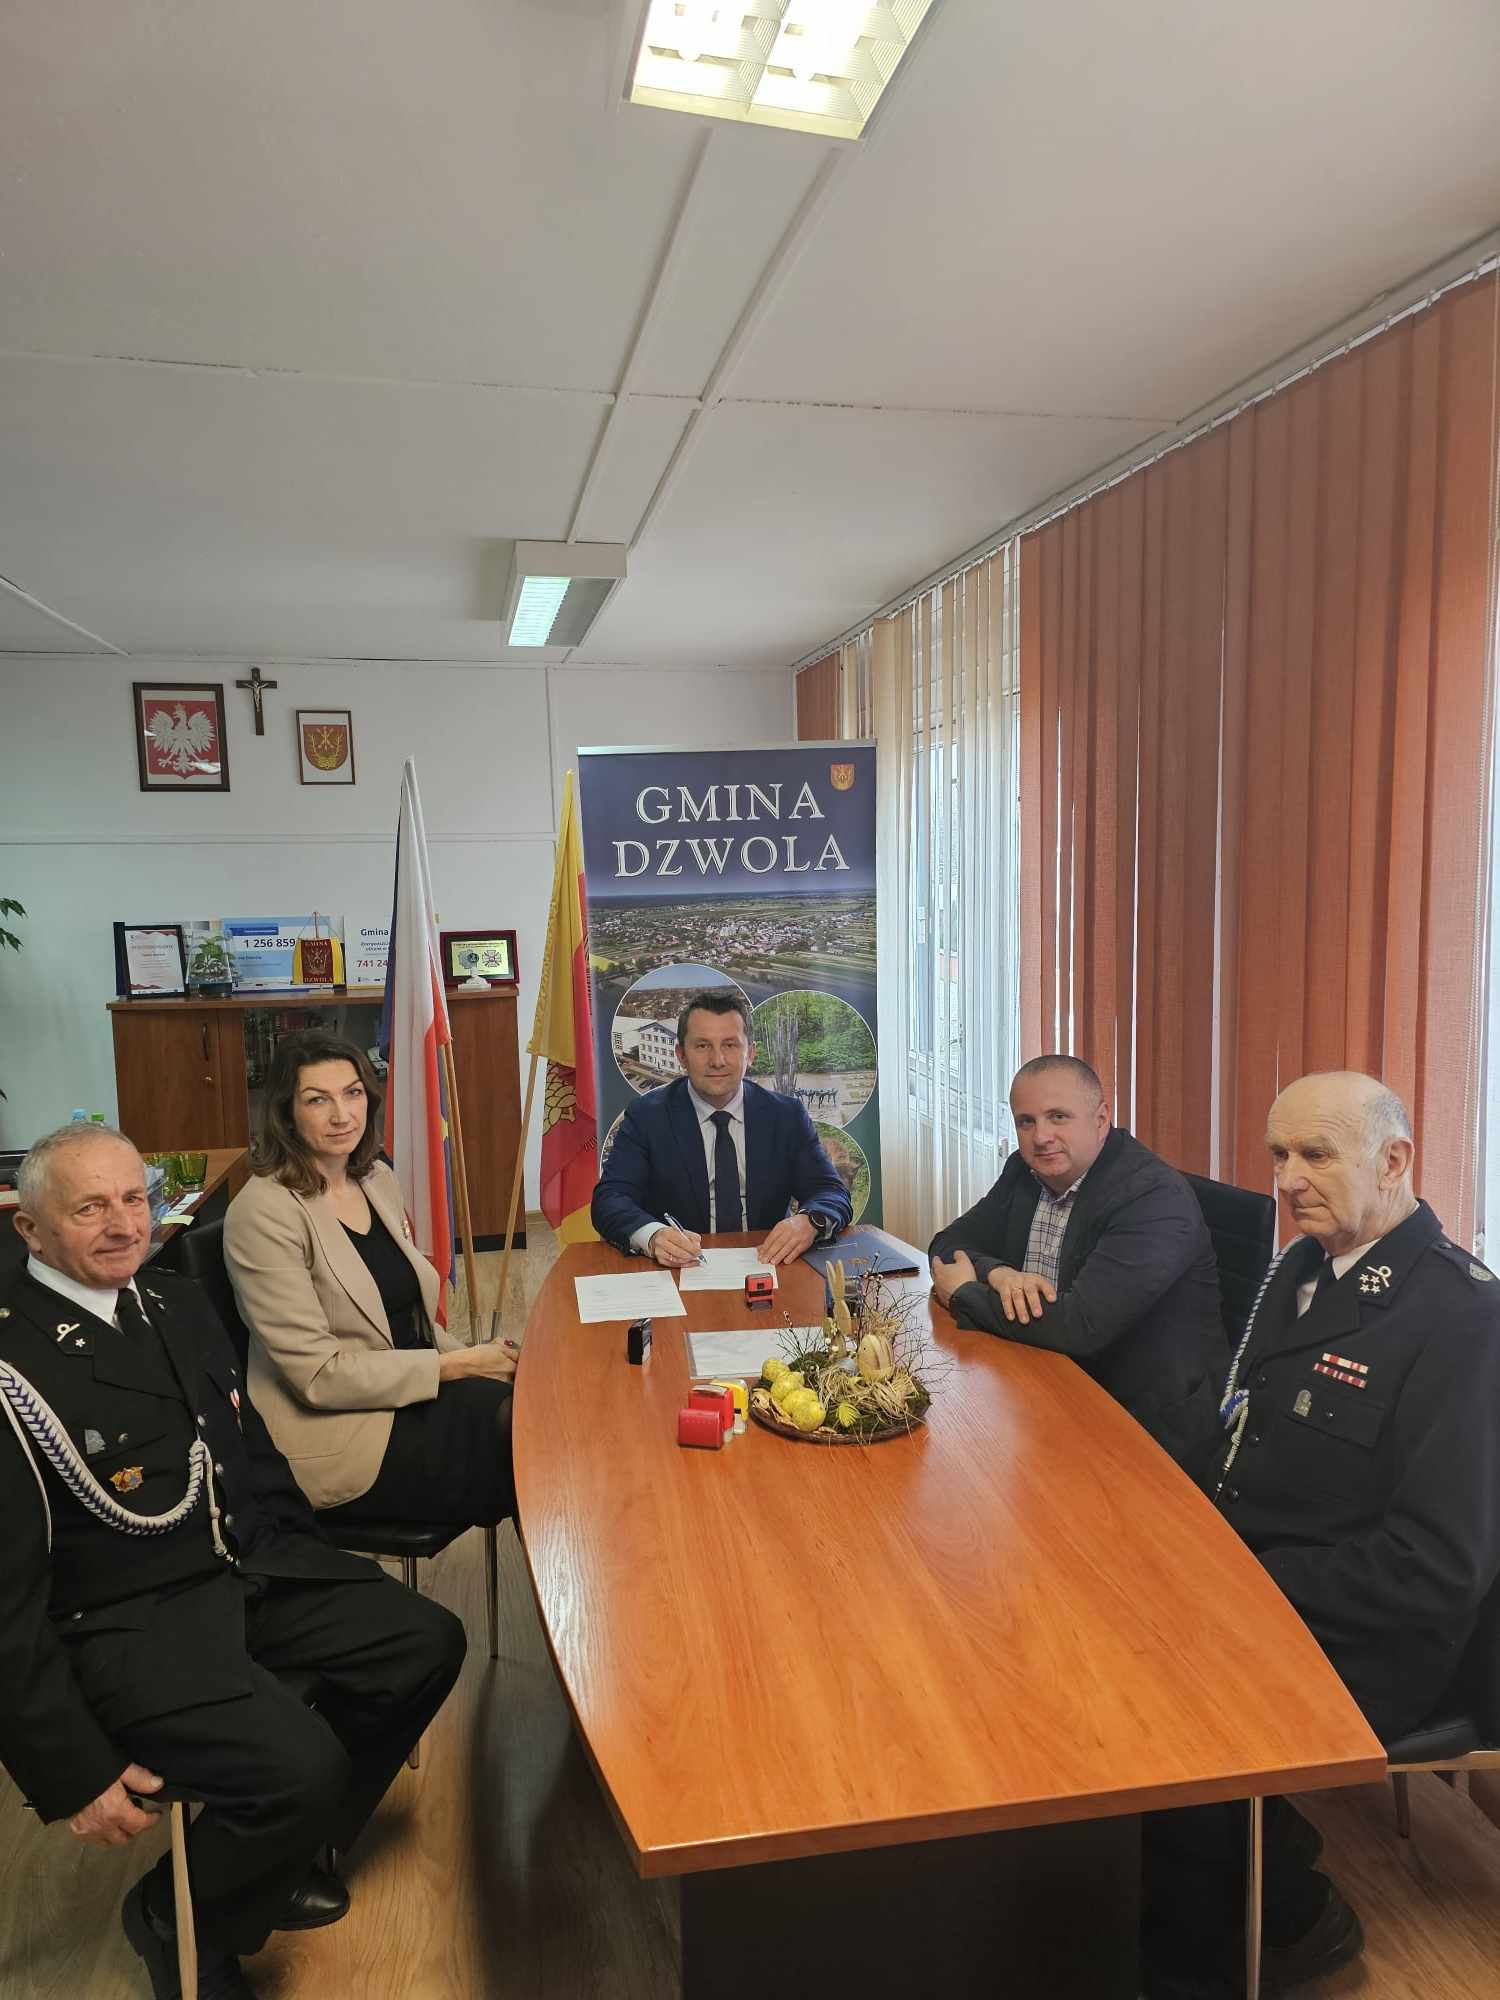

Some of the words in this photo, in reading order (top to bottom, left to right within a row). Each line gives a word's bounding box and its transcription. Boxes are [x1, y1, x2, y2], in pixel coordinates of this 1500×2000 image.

[636, 781, 825, 824] GMINA
[612, 834, 851, 878] DZWOLA
[360, 928, 389, 936] Gmina
[243, 939, 249, 948] 1
[254, 939, 273, 947] 256
[276, 938, 296, 947] 859
[356, 960, 374, 968] 741
